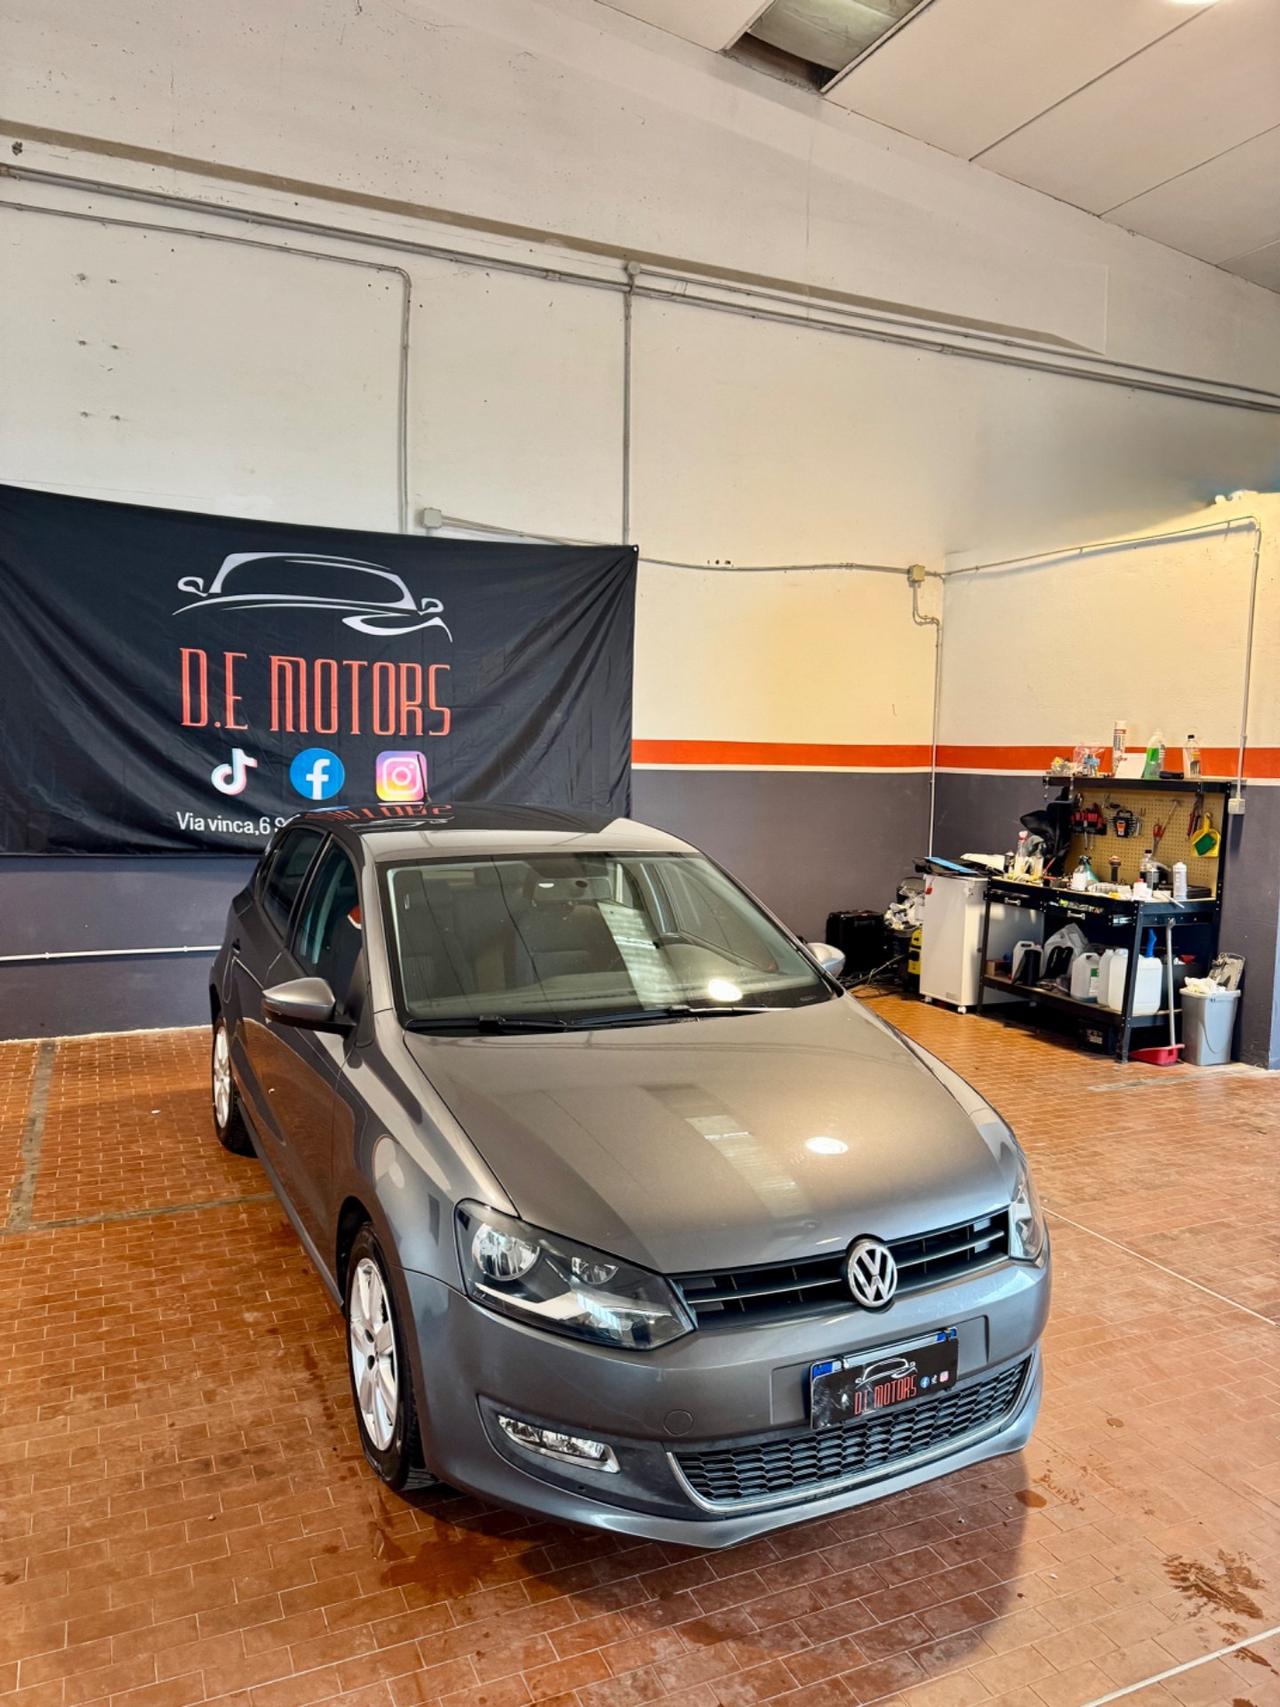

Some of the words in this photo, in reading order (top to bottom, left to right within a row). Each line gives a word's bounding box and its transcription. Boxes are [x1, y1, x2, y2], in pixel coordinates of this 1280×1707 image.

[180, 648, 248, 730] D.E
[269, 655, 451, 737] MOTORS
[176, 811, 204, 831] Via
[207, 815, 271, 836] vinca,6
[874, 1375, 917, 1408] MOTORS
